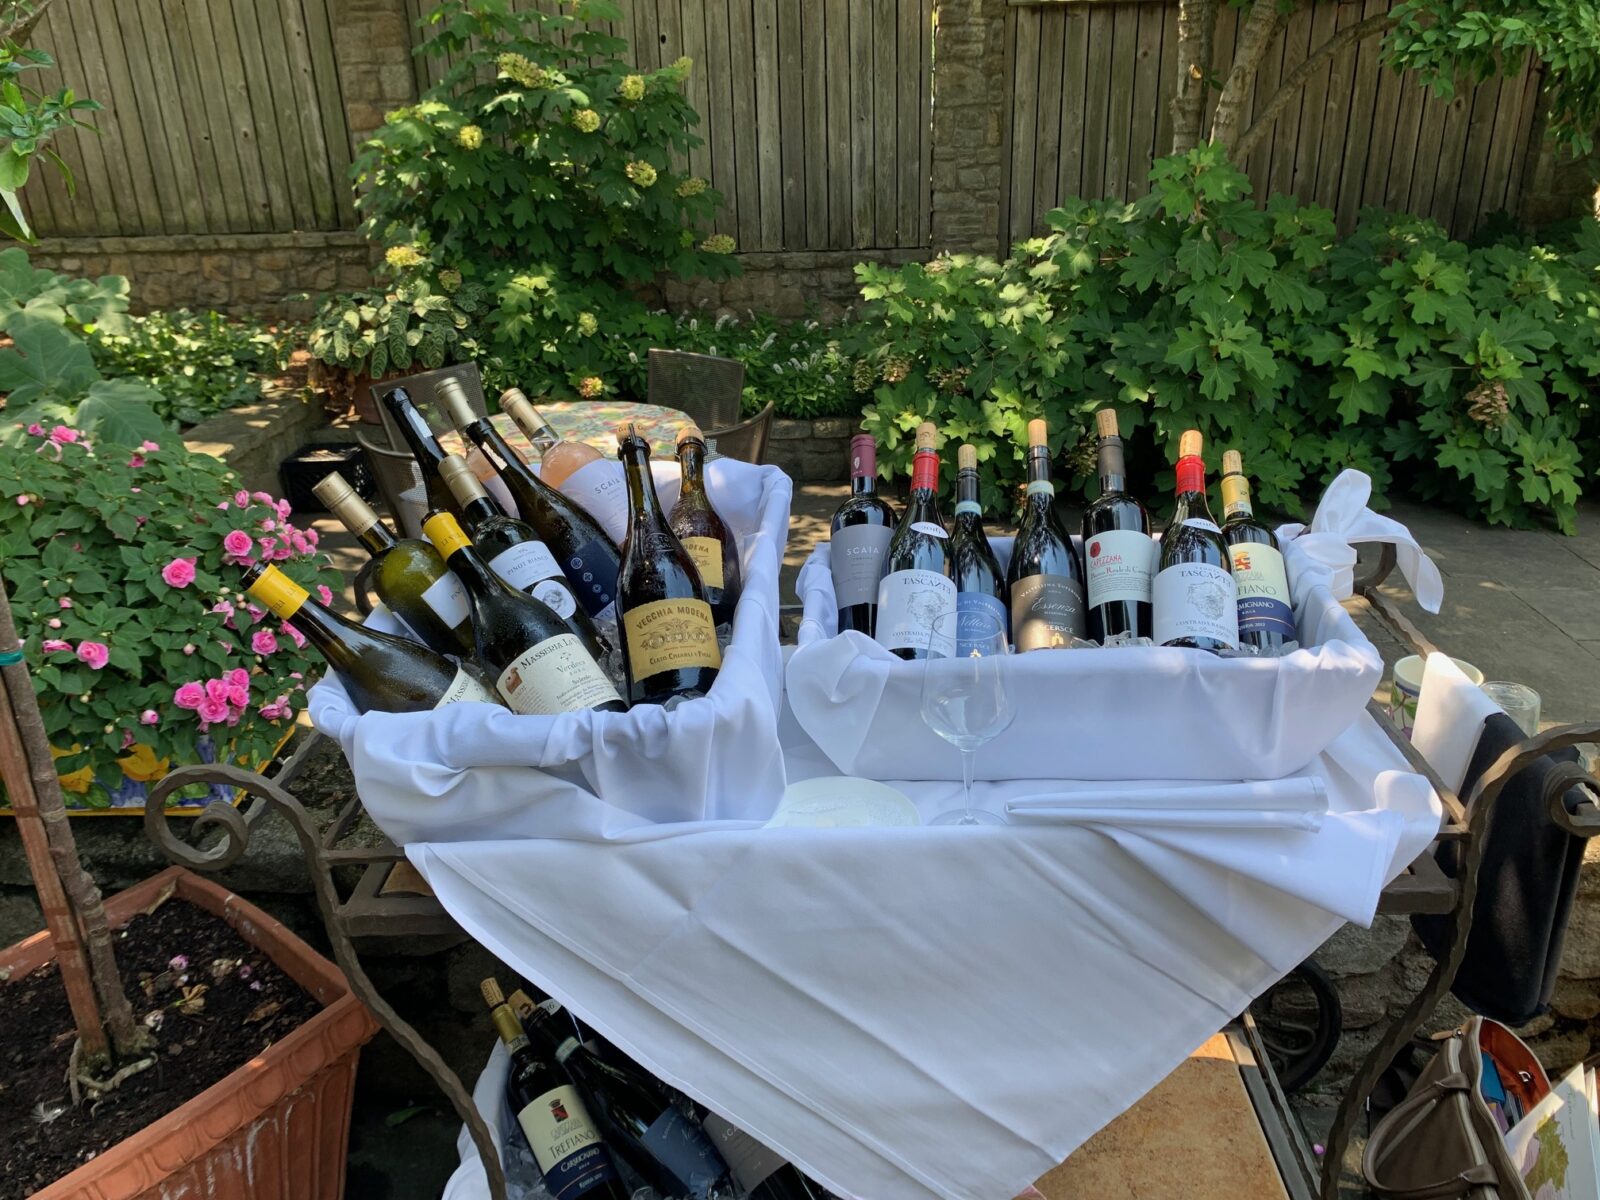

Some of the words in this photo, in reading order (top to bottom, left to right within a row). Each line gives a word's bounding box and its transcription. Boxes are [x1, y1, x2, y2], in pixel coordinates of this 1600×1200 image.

[847, 545, 880, 556] SCAIA
[636, 607, 673, 630] VECCHIA
[677, 605, 709, 623] MODENA
[520, 641, 564, 671] MASSERIA
[548, 1128, 598, 1160] TREFIANO
